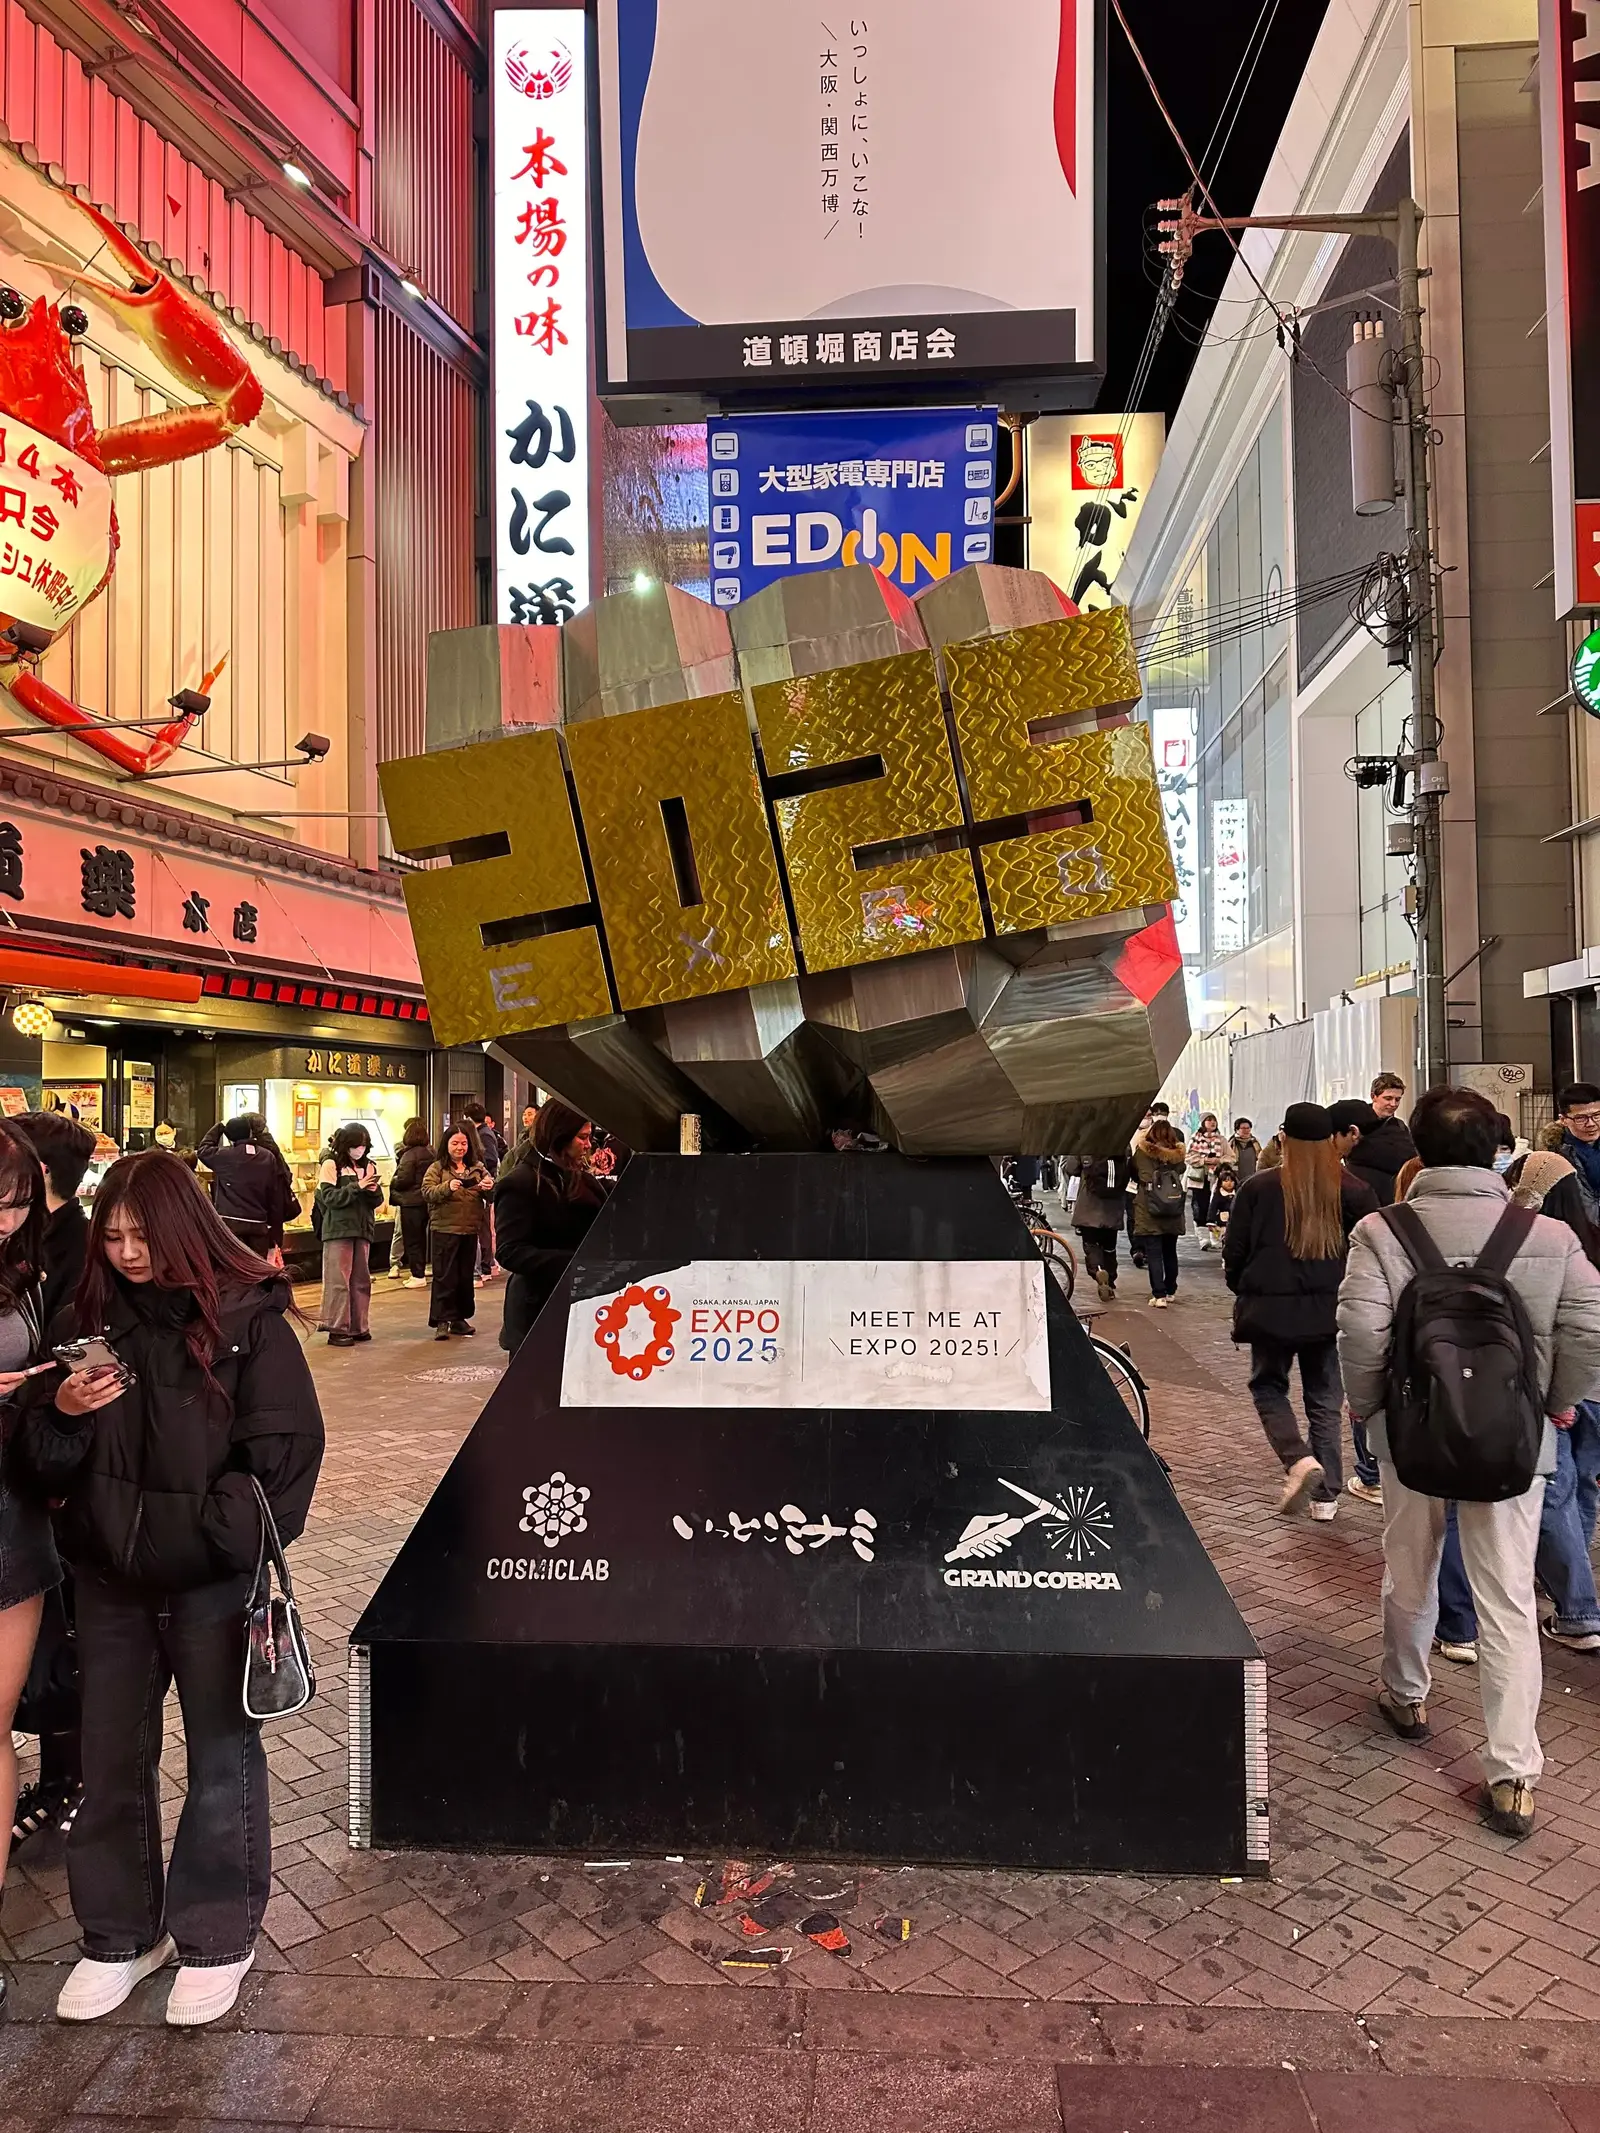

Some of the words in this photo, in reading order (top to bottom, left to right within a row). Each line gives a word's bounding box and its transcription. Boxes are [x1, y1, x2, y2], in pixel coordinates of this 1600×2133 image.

[510, 127, 568, 356] 本場の味
[742, 327, 956, 367] 道頓堀商店会
[0, 427, 84, 509] 4本
[758, 459, 946, 493] 大型家電専門店
[752, 508, 951, 584] EDION
[691, 1308, 780, 1334] EXPO
[850, 1311, 915, 1328] MEET
[928, 1311, 962, 1328] ME
[973, 1311, 1002, 1328] AT
[690, 1337, 778, 1362] 2025
[850, 1339, 917, 1356] EXPO
[929, 1339, 999, 1356] 2025!
[486, 1558, 610, 1581] COSMICLAB
